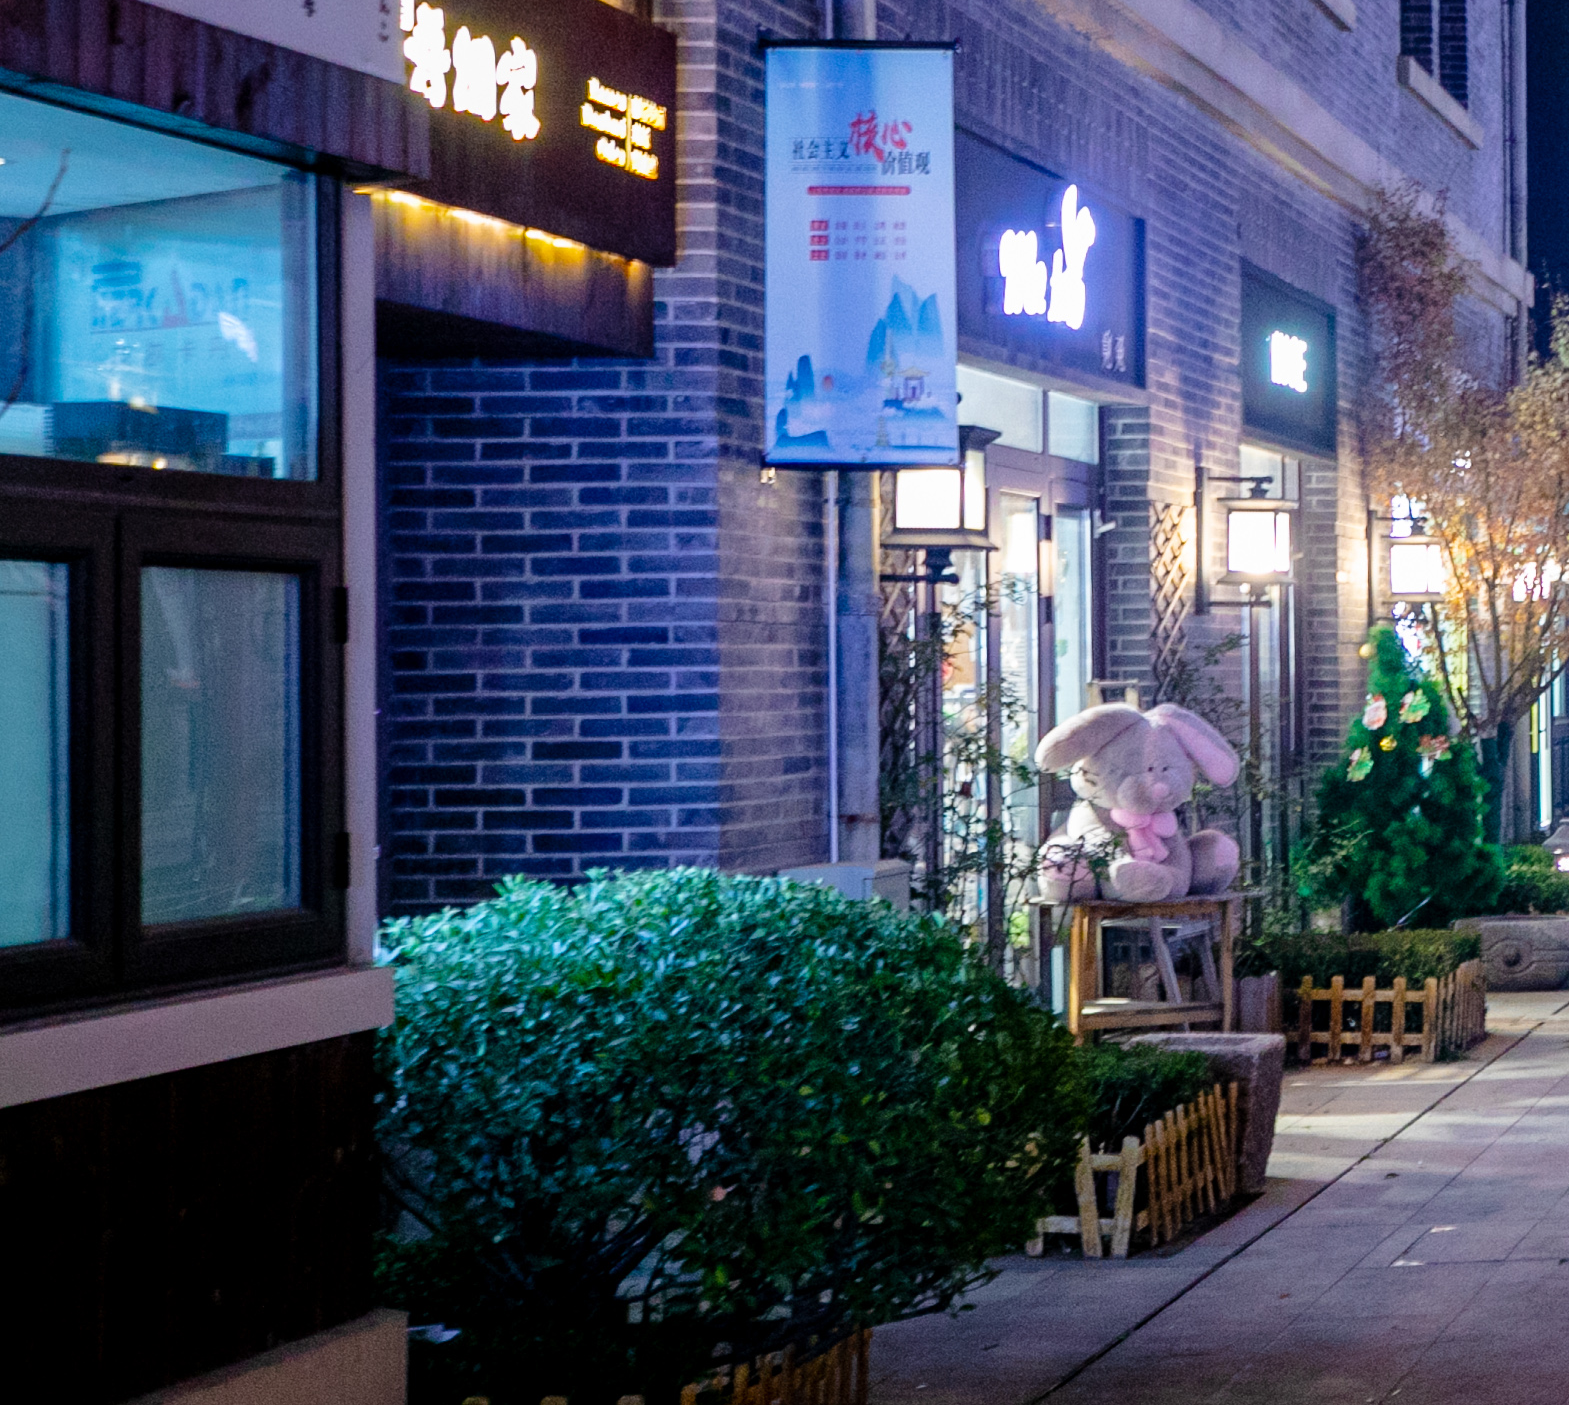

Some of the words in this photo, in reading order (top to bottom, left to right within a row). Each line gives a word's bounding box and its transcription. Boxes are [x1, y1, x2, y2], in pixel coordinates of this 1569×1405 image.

[848, 109, 914, 163] 核心
[792, 138, 850, 161] 社会主义
[881, 150, 932, 176] 价值观
